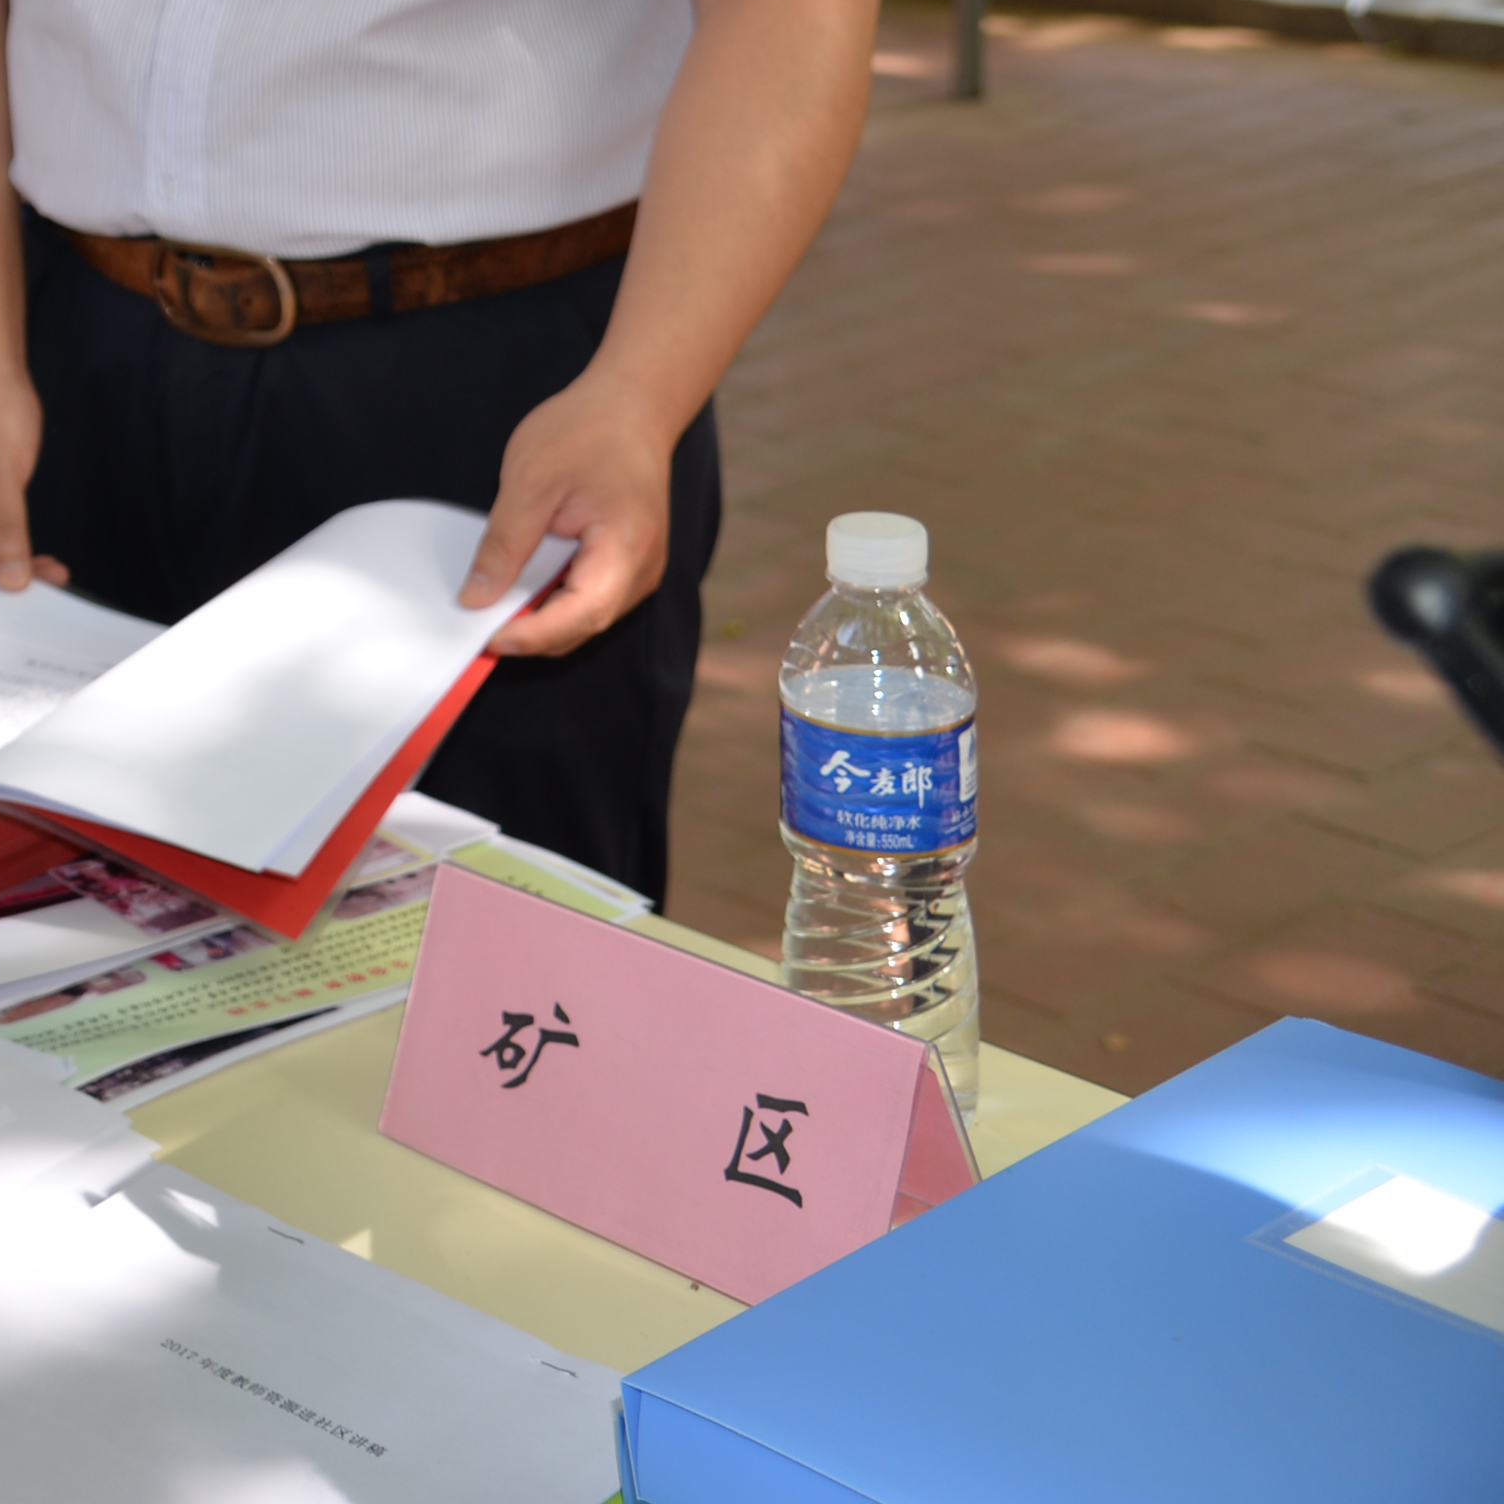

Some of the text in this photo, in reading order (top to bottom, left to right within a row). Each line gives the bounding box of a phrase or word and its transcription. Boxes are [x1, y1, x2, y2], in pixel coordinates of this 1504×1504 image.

[820, 750, 933, 809] 今麦郎
[836, 809, 922, 830] 软化纯净水
